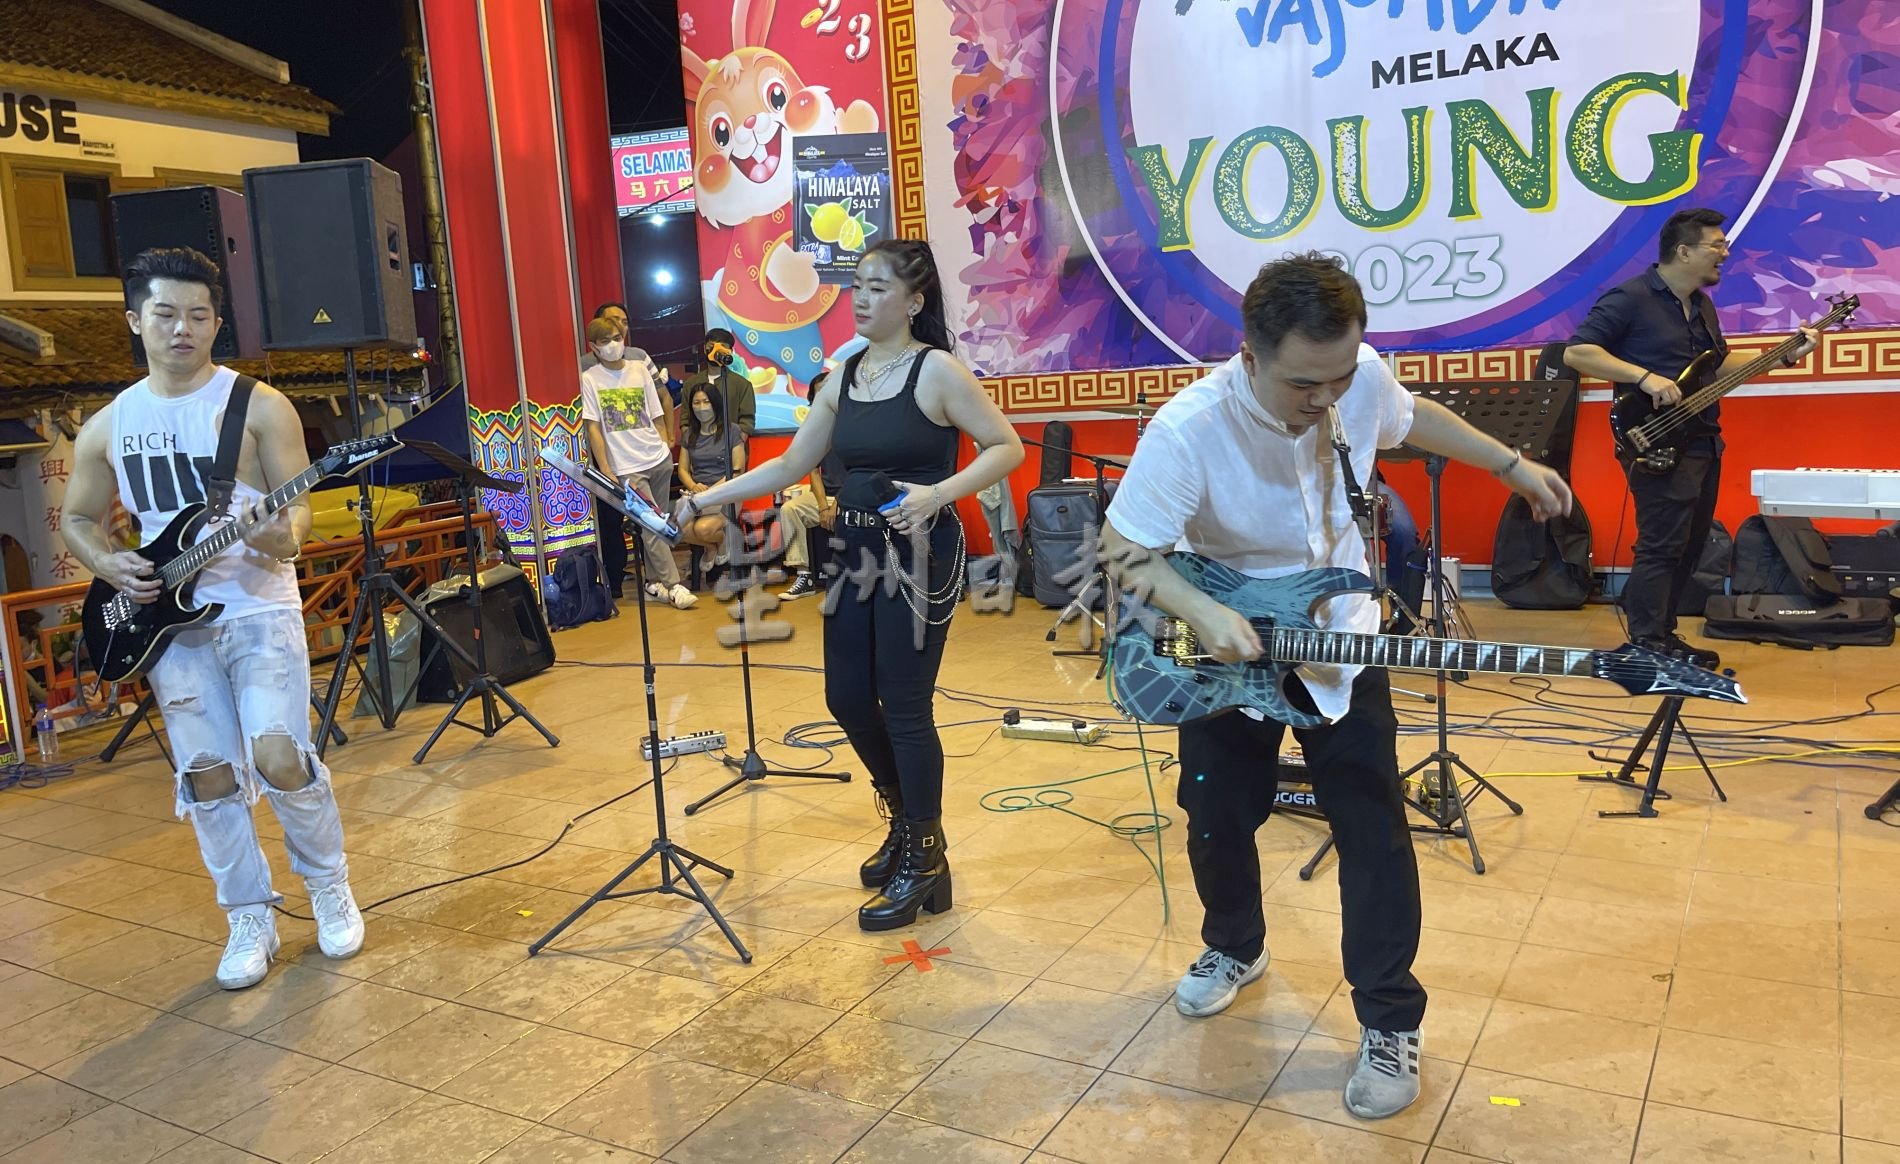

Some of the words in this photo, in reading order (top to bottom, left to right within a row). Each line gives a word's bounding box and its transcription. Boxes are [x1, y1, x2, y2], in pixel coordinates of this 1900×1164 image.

[1371, 32, 1560, 89] MELAKA
[1127, 69, 1703, 252] YOUNG
[808, 176, 880, 197] HIMALAYA
[852, 199, 880, 209] SALT
[123, 432, 176, 453] RICH
[348, 449, 379, 464] Ibanez
